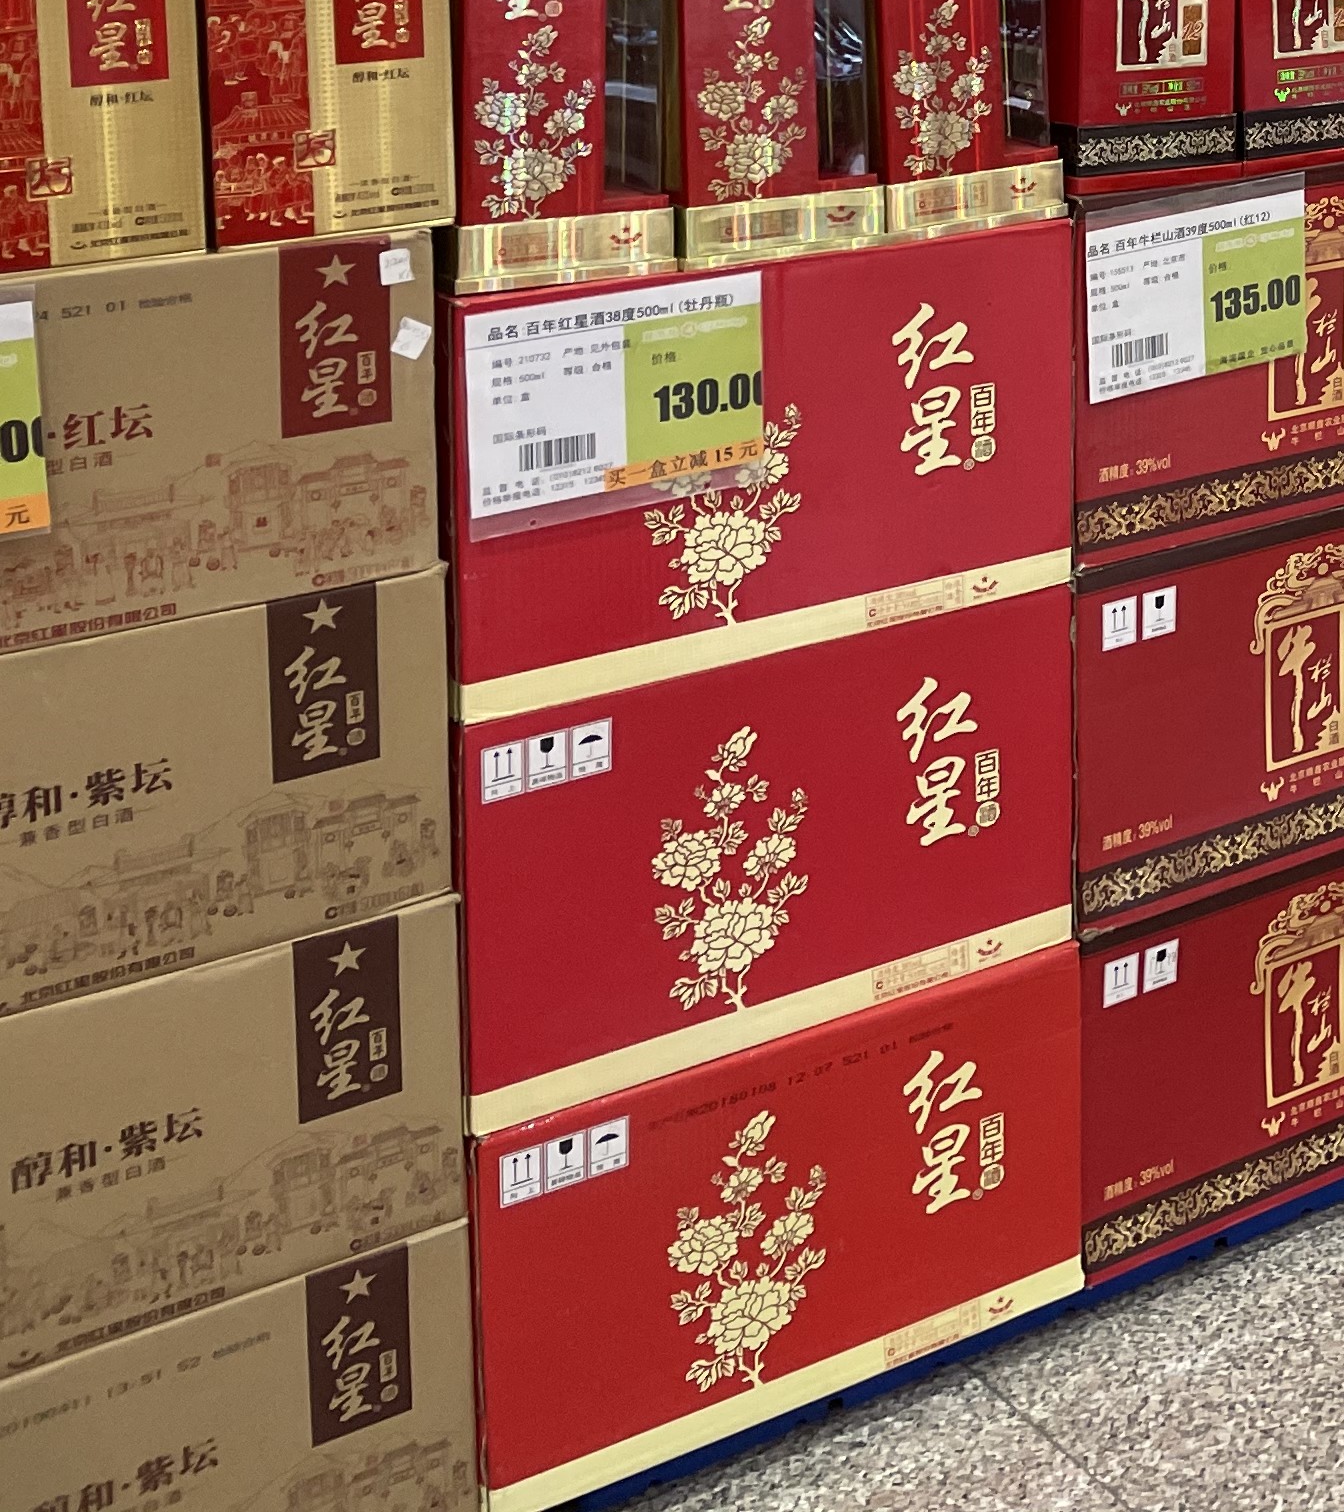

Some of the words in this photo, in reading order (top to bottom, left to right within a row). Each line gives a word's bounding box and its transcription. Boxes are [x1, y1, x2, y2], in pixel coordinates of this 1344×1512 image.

[61, 304, 92, 320] 521
[105, 300, 126, 313] 01
[487, 326, 519, 342] 品名
[1209, 272, 1301, 324] 135.00
[295, 300, 359, 419] 红星
[651, 350, 679, 365] 价格
[891, 302, 975, 476] 红星
[608, 449, 709, 488] 买一盒立减
[714, 445, 734, 463] 15
[739, 439, 760, 459] 元
[4, 503, 31, 526] 元
[283, 646, 348, 761] 红星
[896, 677, 979, 848] 红星
[309, 989, 370, 1101] 红星
[10, 1106, 205, 1194] 醇和·紫坛
[903, 1050, 983, 1215] 红星
[321, 1315, 381, 1423] 红星
